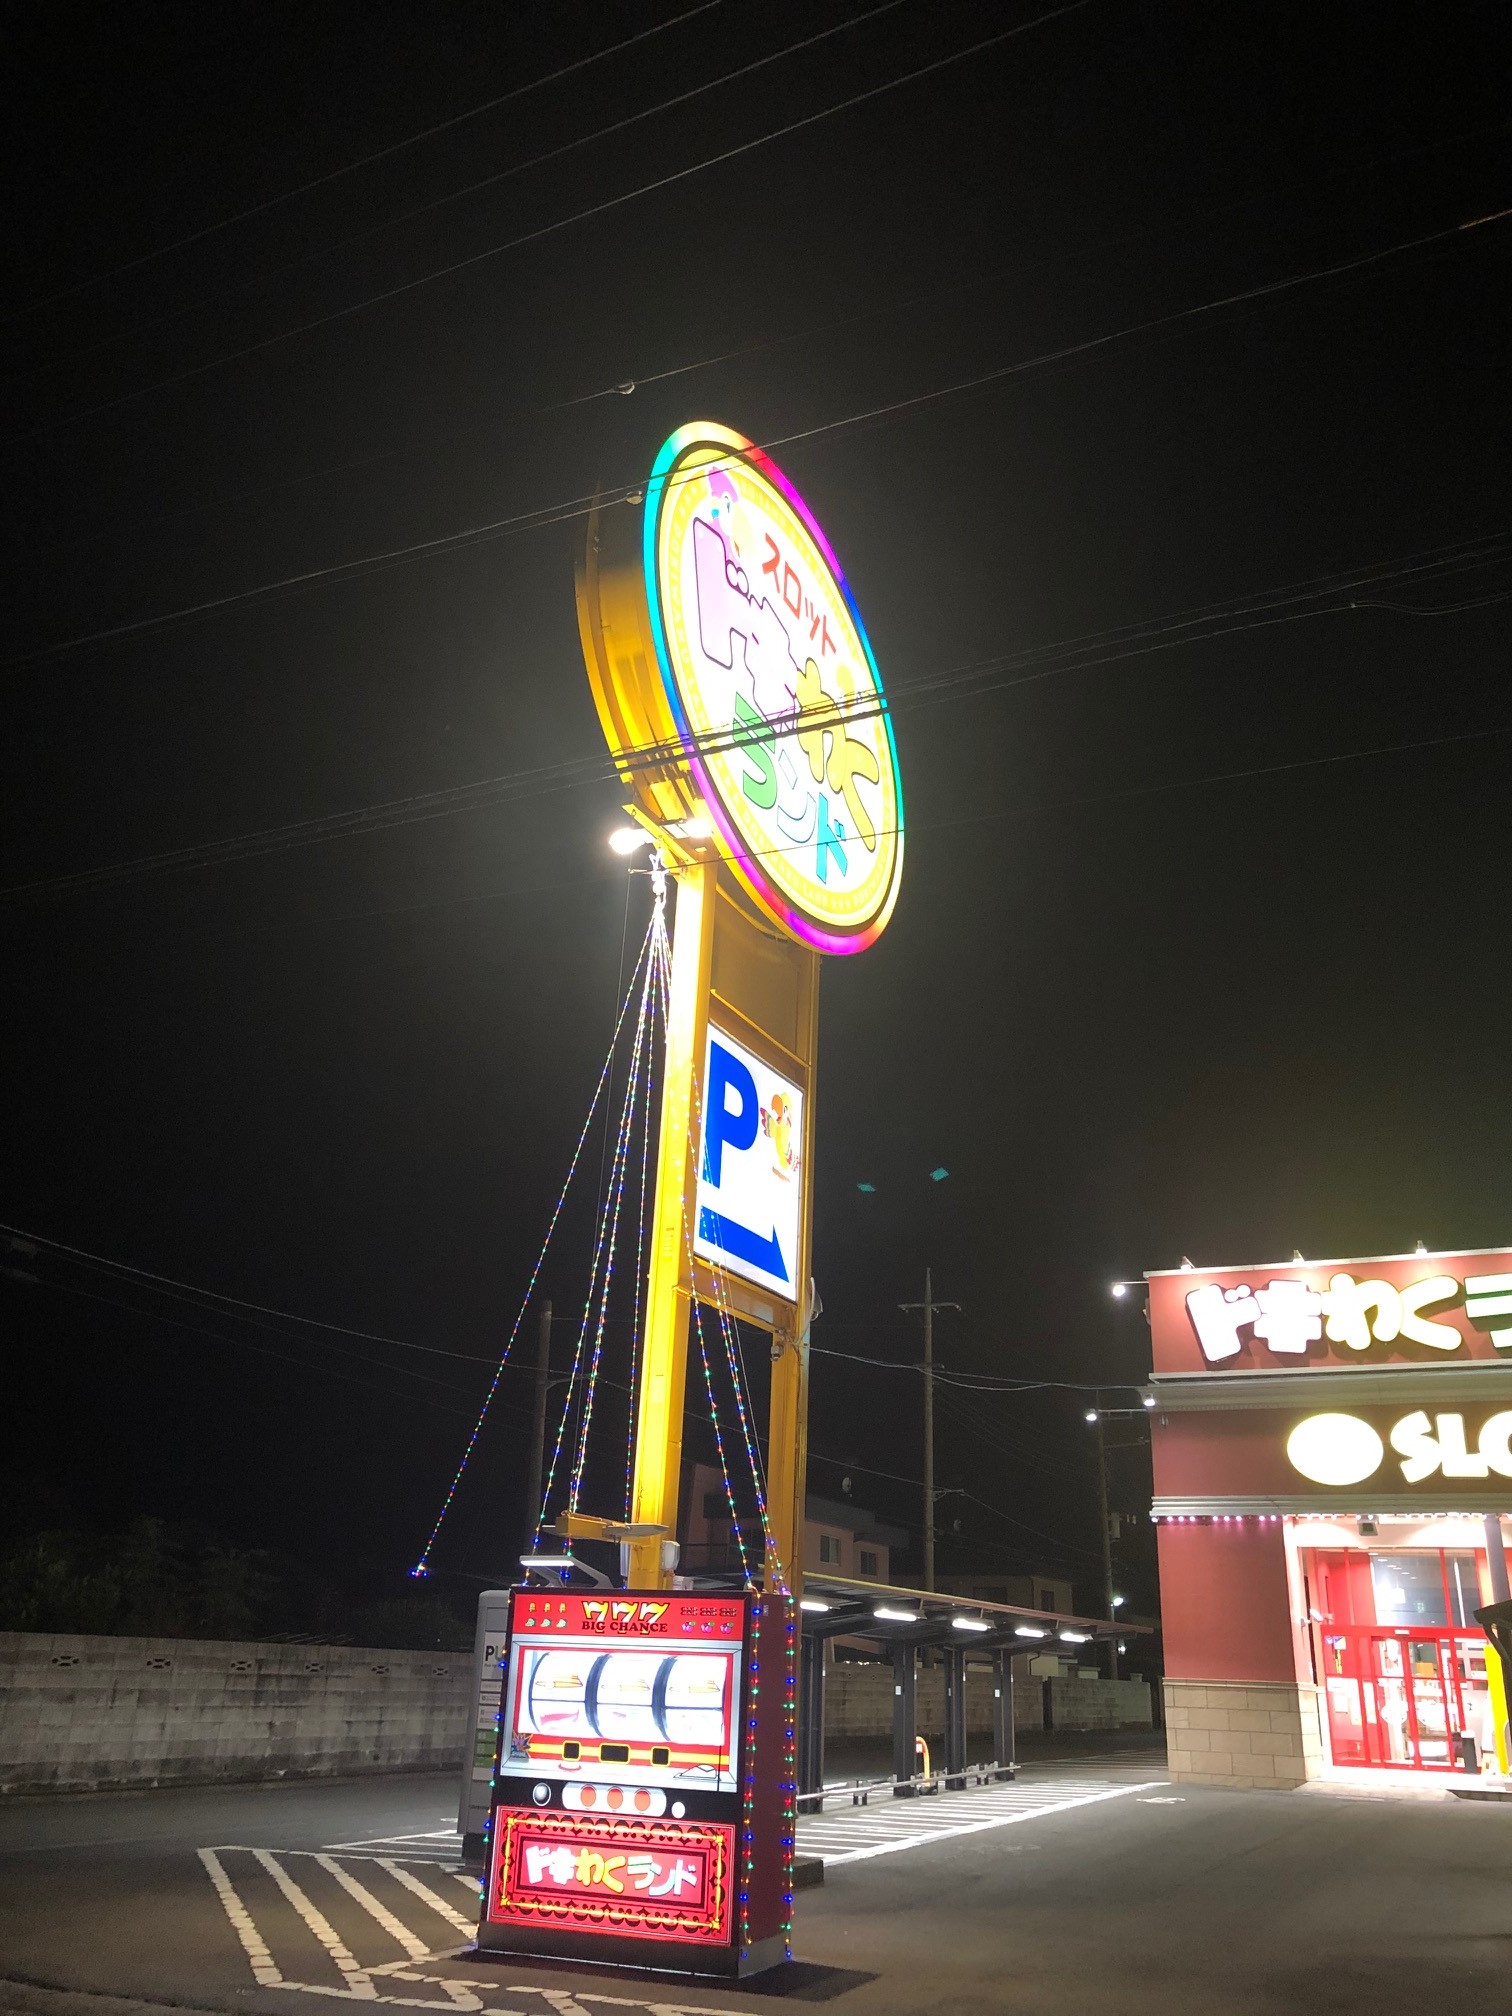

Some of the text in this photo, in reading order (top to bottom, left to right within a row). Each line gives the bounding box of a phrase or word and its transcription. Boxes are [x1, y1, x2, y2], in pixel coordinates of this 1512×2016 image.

[761, 532, 837, 657] スロット
[702, 1041, 759, 1188] P
[581, 1620, 669, 1634] BIG CHANCE
